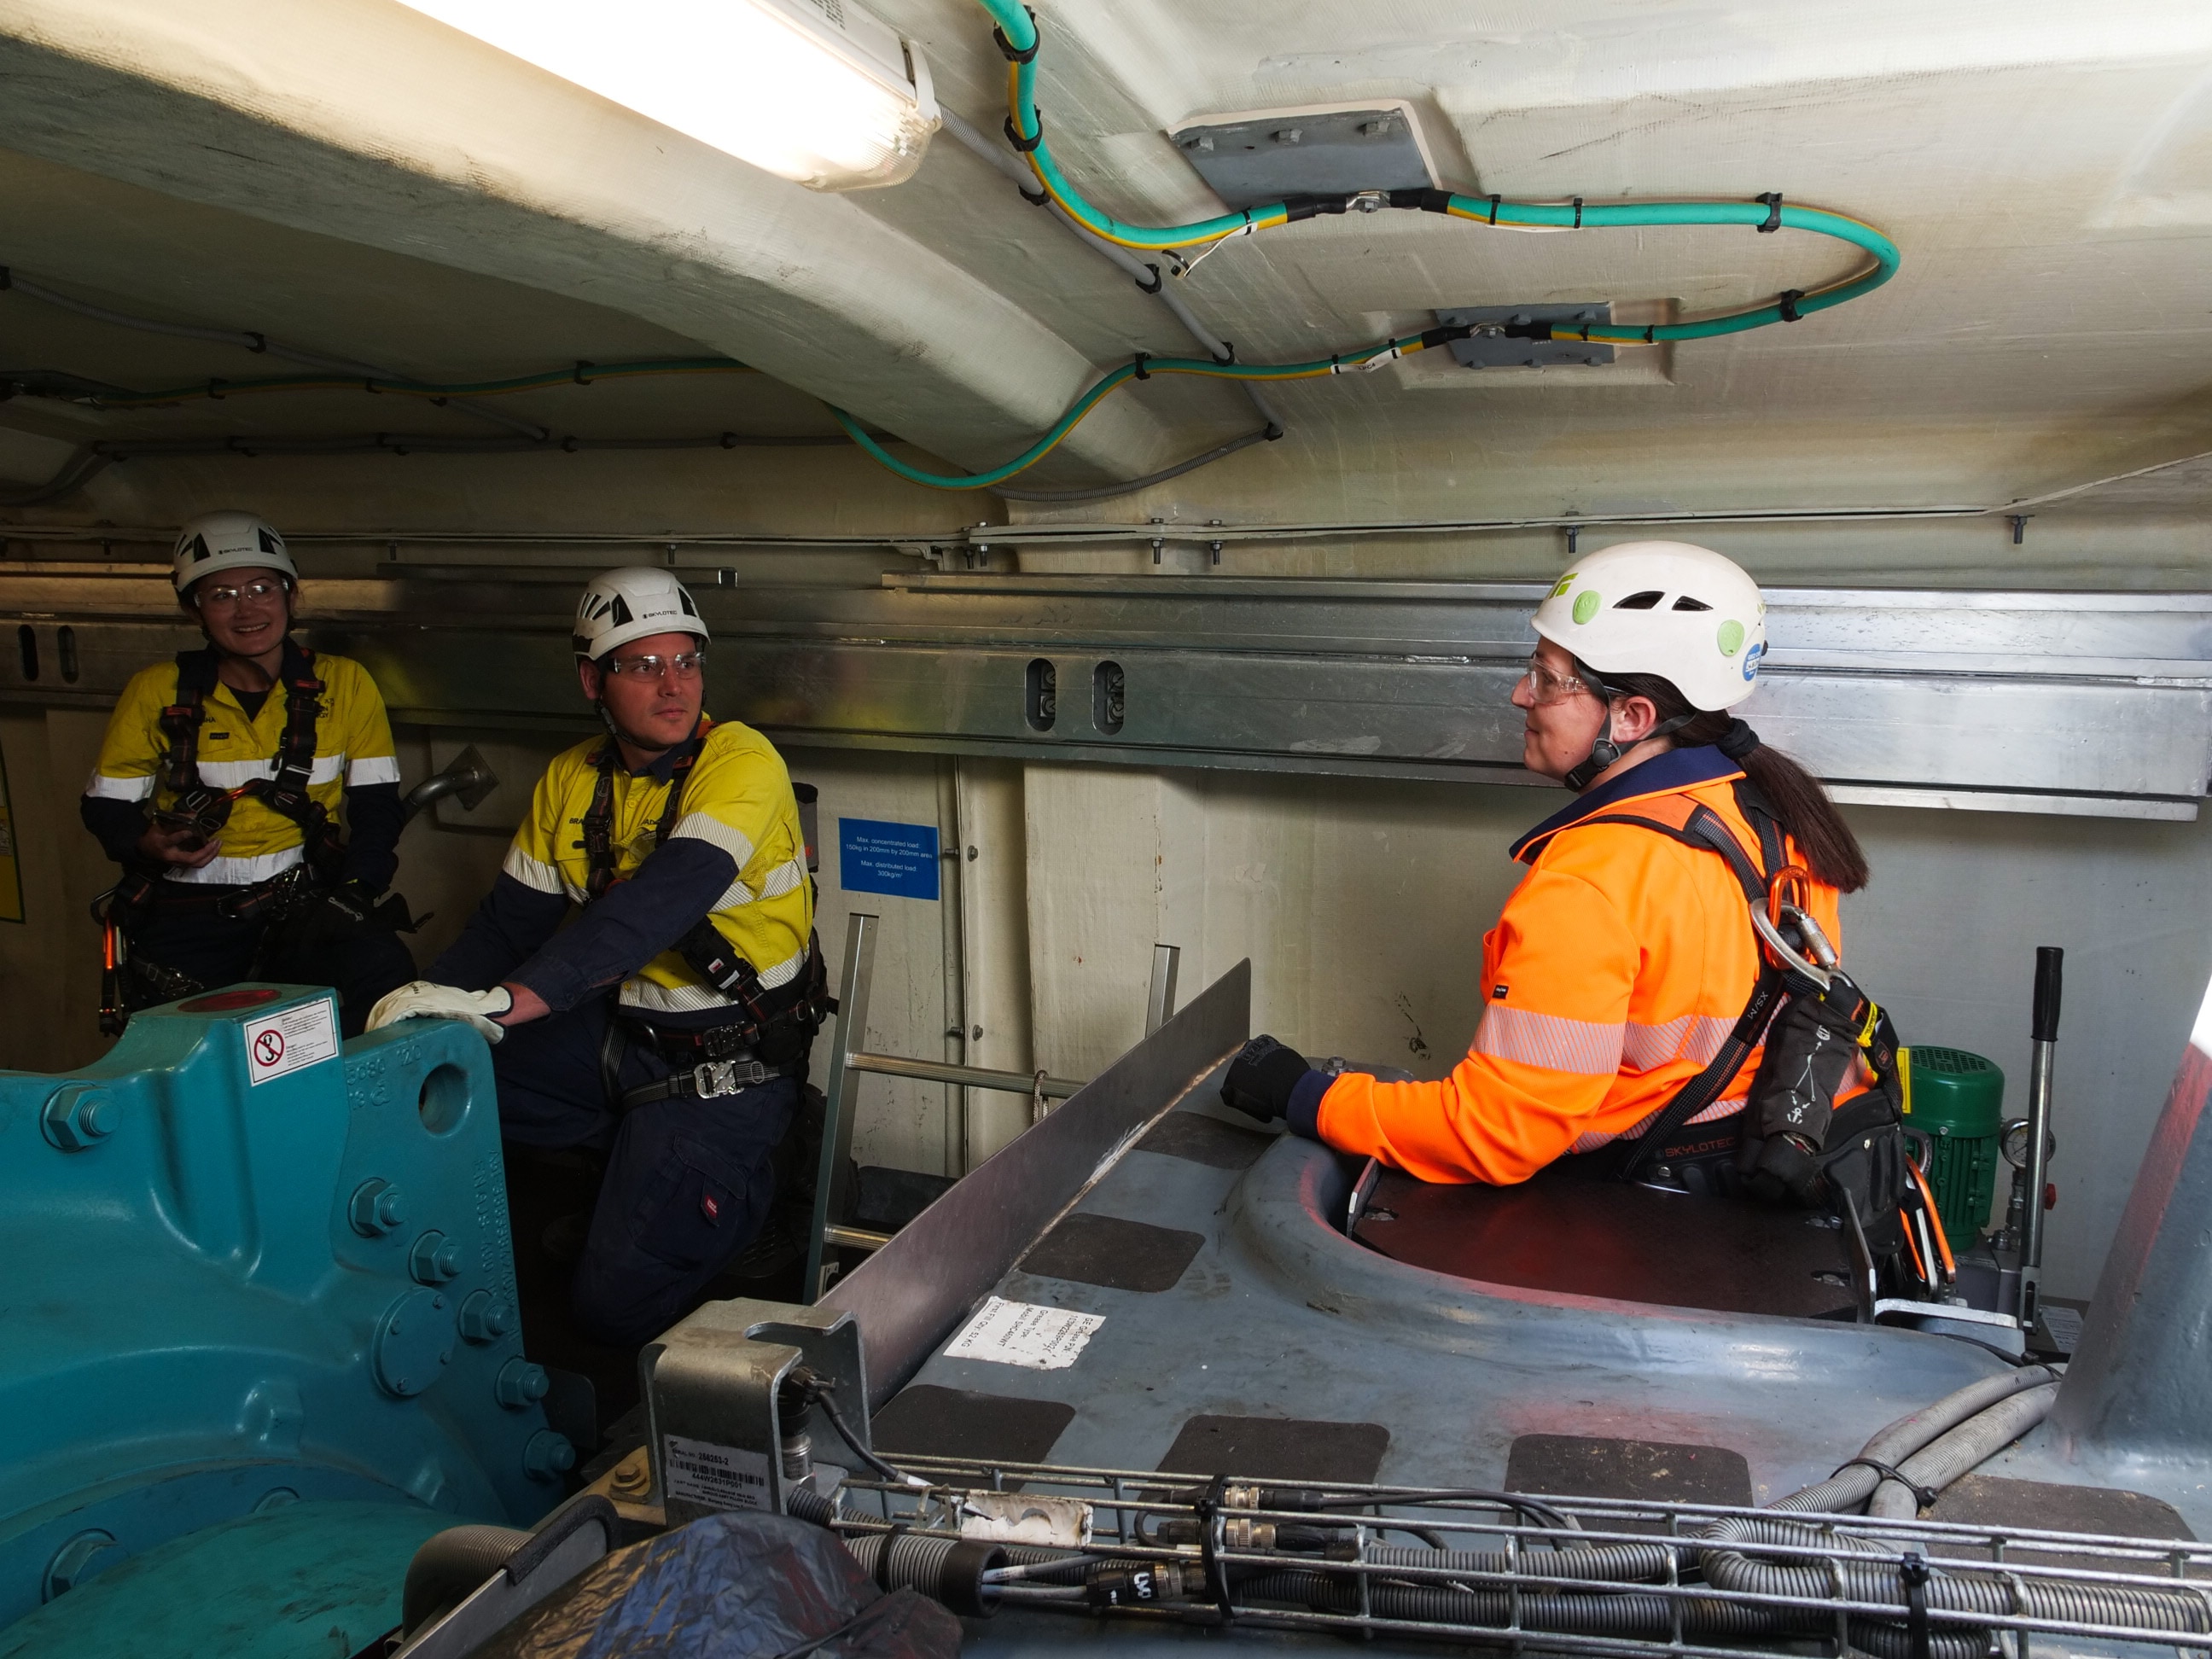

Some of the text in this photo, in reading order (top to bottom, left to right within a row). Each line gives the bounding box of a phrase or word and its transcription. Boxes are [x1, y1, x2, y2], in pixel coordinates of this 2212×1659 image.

[847, 844, 862, 853] 150kg
[871, 838, 905, 847] concentrated
[1747, 992, 1768, 1020] XS/M
[1664, 1137, 1736, 1158] SKYLOTEC
[1029, 1309, 1050, 1327] Grease
[1068, 1324, 1089, 1343] Grease
